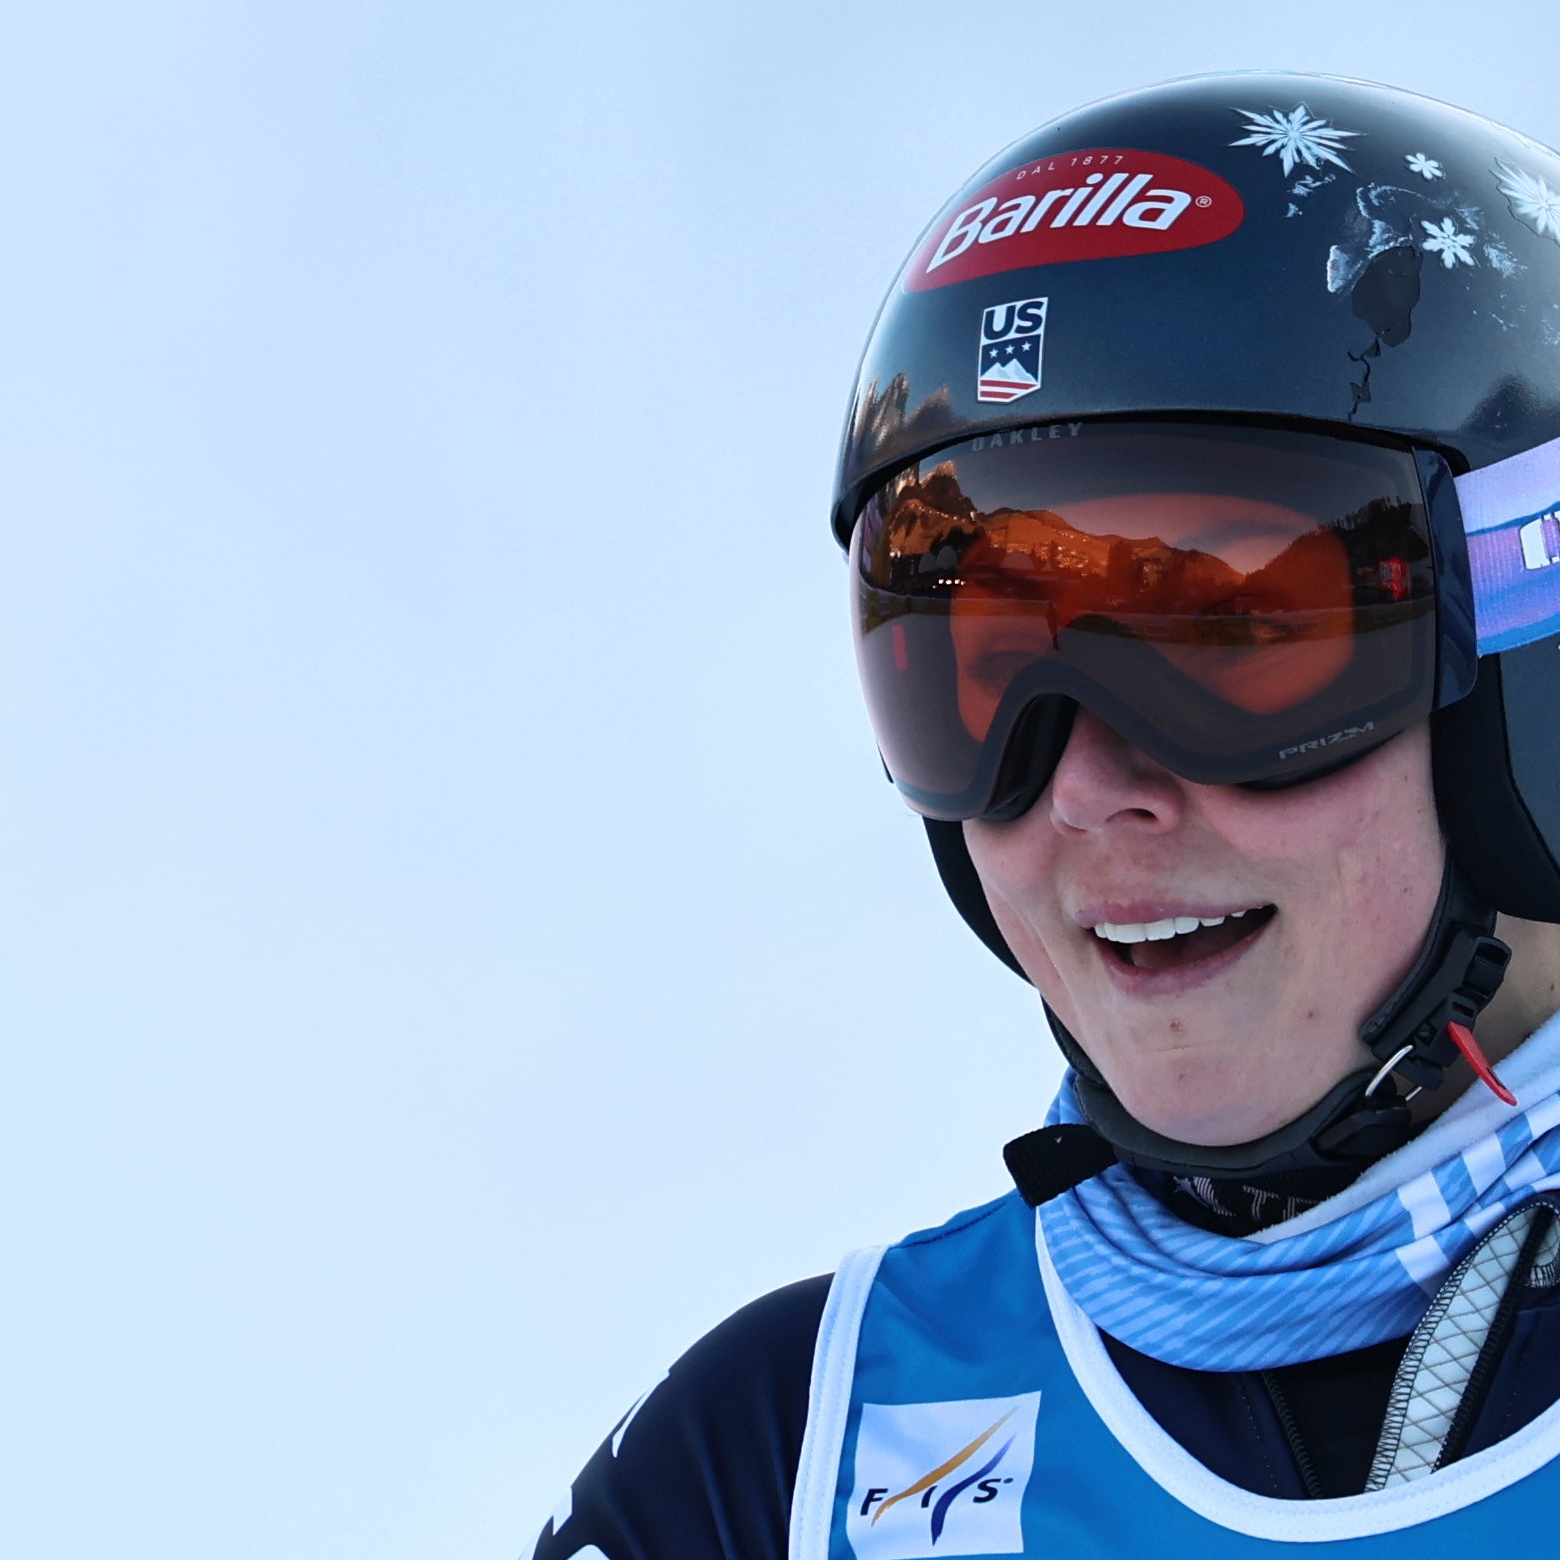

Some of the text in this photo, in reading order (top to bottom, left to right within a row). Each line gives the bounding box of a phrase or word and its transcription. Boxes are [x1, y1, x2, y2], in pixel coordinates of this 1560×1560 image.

[1016, 155, 1124, 180] DAL 1877
[983, 300, 1045, 341] US
[972, 422, 1083, 452] OAKLEY
[1279, 720, 1376, 760] PRIZM
